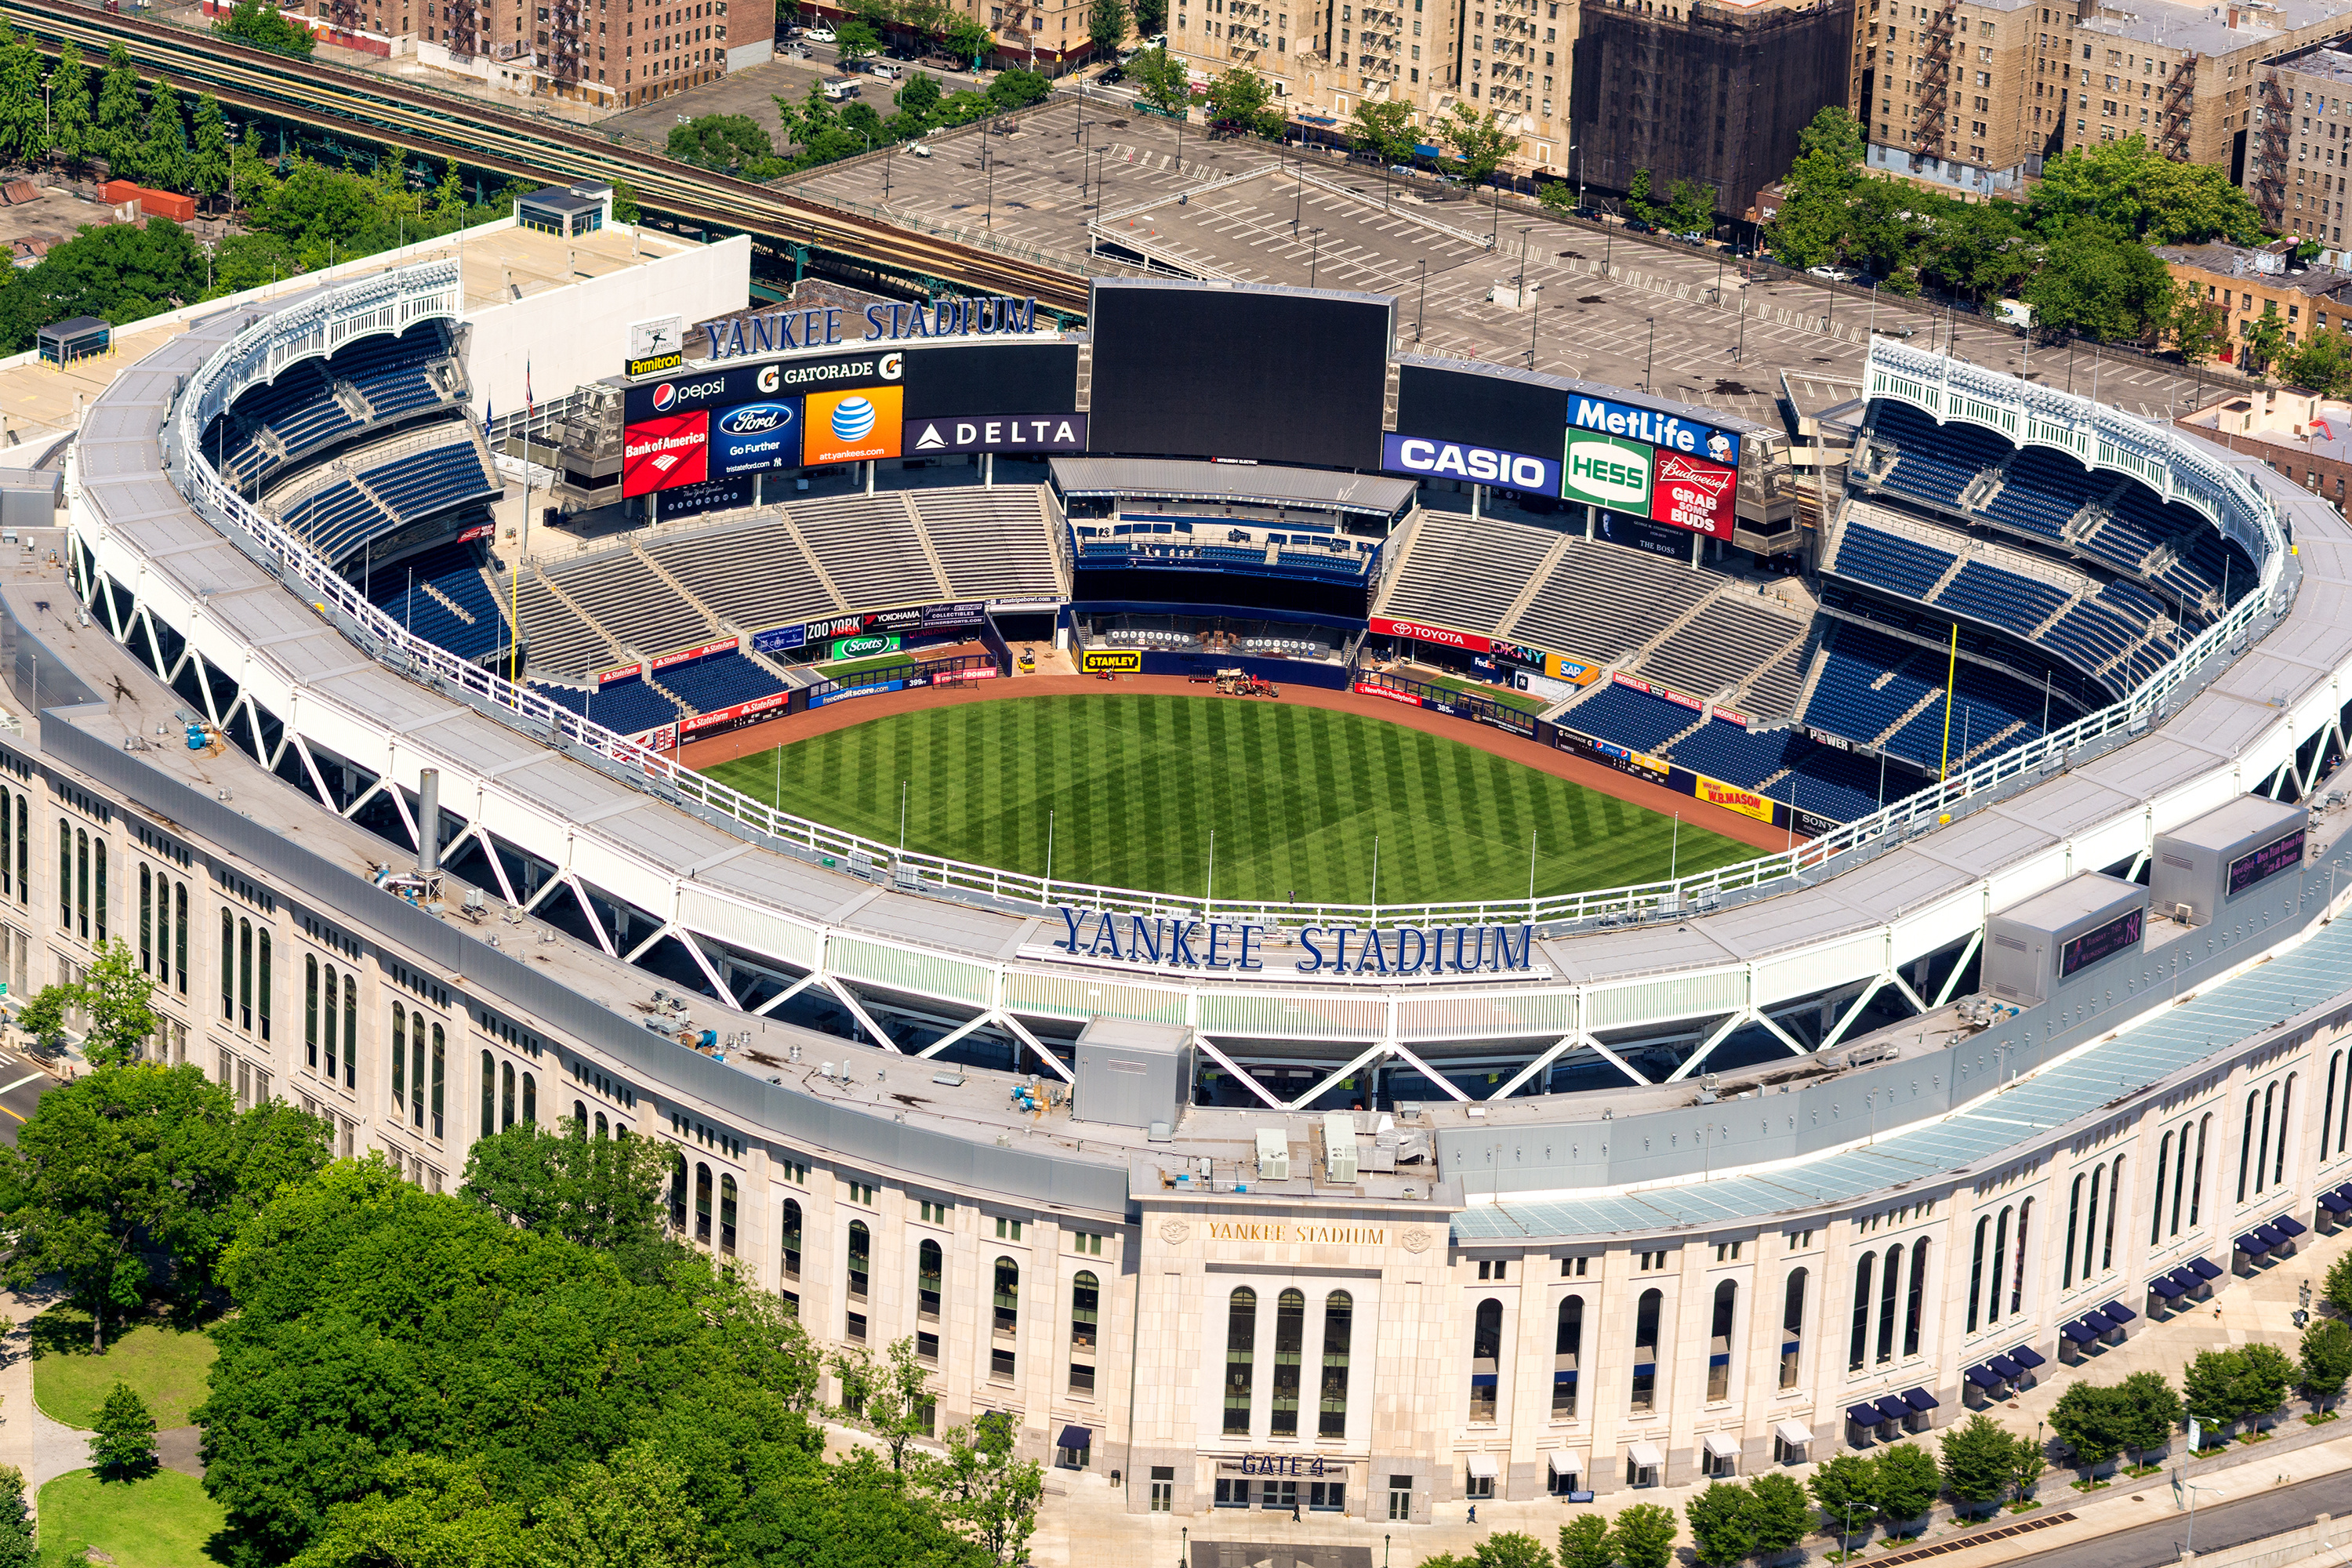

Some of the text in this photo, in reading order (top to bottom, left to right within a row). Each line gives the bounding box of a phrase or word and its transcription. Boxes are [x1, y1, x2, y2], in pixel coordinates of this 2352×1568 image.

[645, 327, 668, 337] Armitron
[700, 296, 1036, 361] YANKEE STADIUM
[631, 354, 681, 375] Armitron
[784, 361, 873, 384] GATORADE
[677, 377, 725, 404] pepsi
[733, 408, 779, 432] Ford
[1576, 399, 1695, 452] MetLife
[956, 421, 1076, 445] DELTA
[626, 433, 706, 458] Bank of America
[730, 441, 780, 456] Go Further
[819, 447, 884, 461] att.yankees.com
[726, 461, 770, 473] tristateford.com
[1399, 439, 1546, 488] CASIO
[1573, 455, 1643, 490] HESS
[1660, 460, 1729, 489] Budweiser
[1671, 487, 1717, 510] GRAB
[1679, 502, 1709, 517] SOME
[1671, 508, 1715, 532] BUDS
[1639, 539, 1675, 554] THE BOSS
[877, 610, 920, 622] YOKOHAMA
[924, 604, 951, 616] Yankees
[807, 622, 829, 640] ZOO
[830, 617, 861, 634] YORK
[1414, 626, 1464, 645] TOYOTA
[502, 646, 520, 660] Sprig
[849, 637, 883, 652] Scotts
[1490, 640, 1546, 664] DKNY
[1088, 656, 1135, 666] STANLEY
[1475, 657, 1496, 670] FedEx
[1561, 663, 1581, 677] SAP
[1615, 673, 1646, 690] MODELL'S
[822, 684, 889, 704] freecreditscore.com
[1668, 691, 1700, 709] MODELL'S
[1713, 706, 1746, 724] MODELL'S
[1564, 731, 1587, 744] GATORADE
[1809, 728, 1848, 751] PWER
[1605, 746, 1620, 755] pepsi
[1802, 815, 1836, 832] SONY
[1057, 903, 1537, 974] YANKEE STADIUM
[1209, 1221, 1385, 1245] YANKEE STADIUM
[1241, 1454, 1325, 1475] GATE 4
